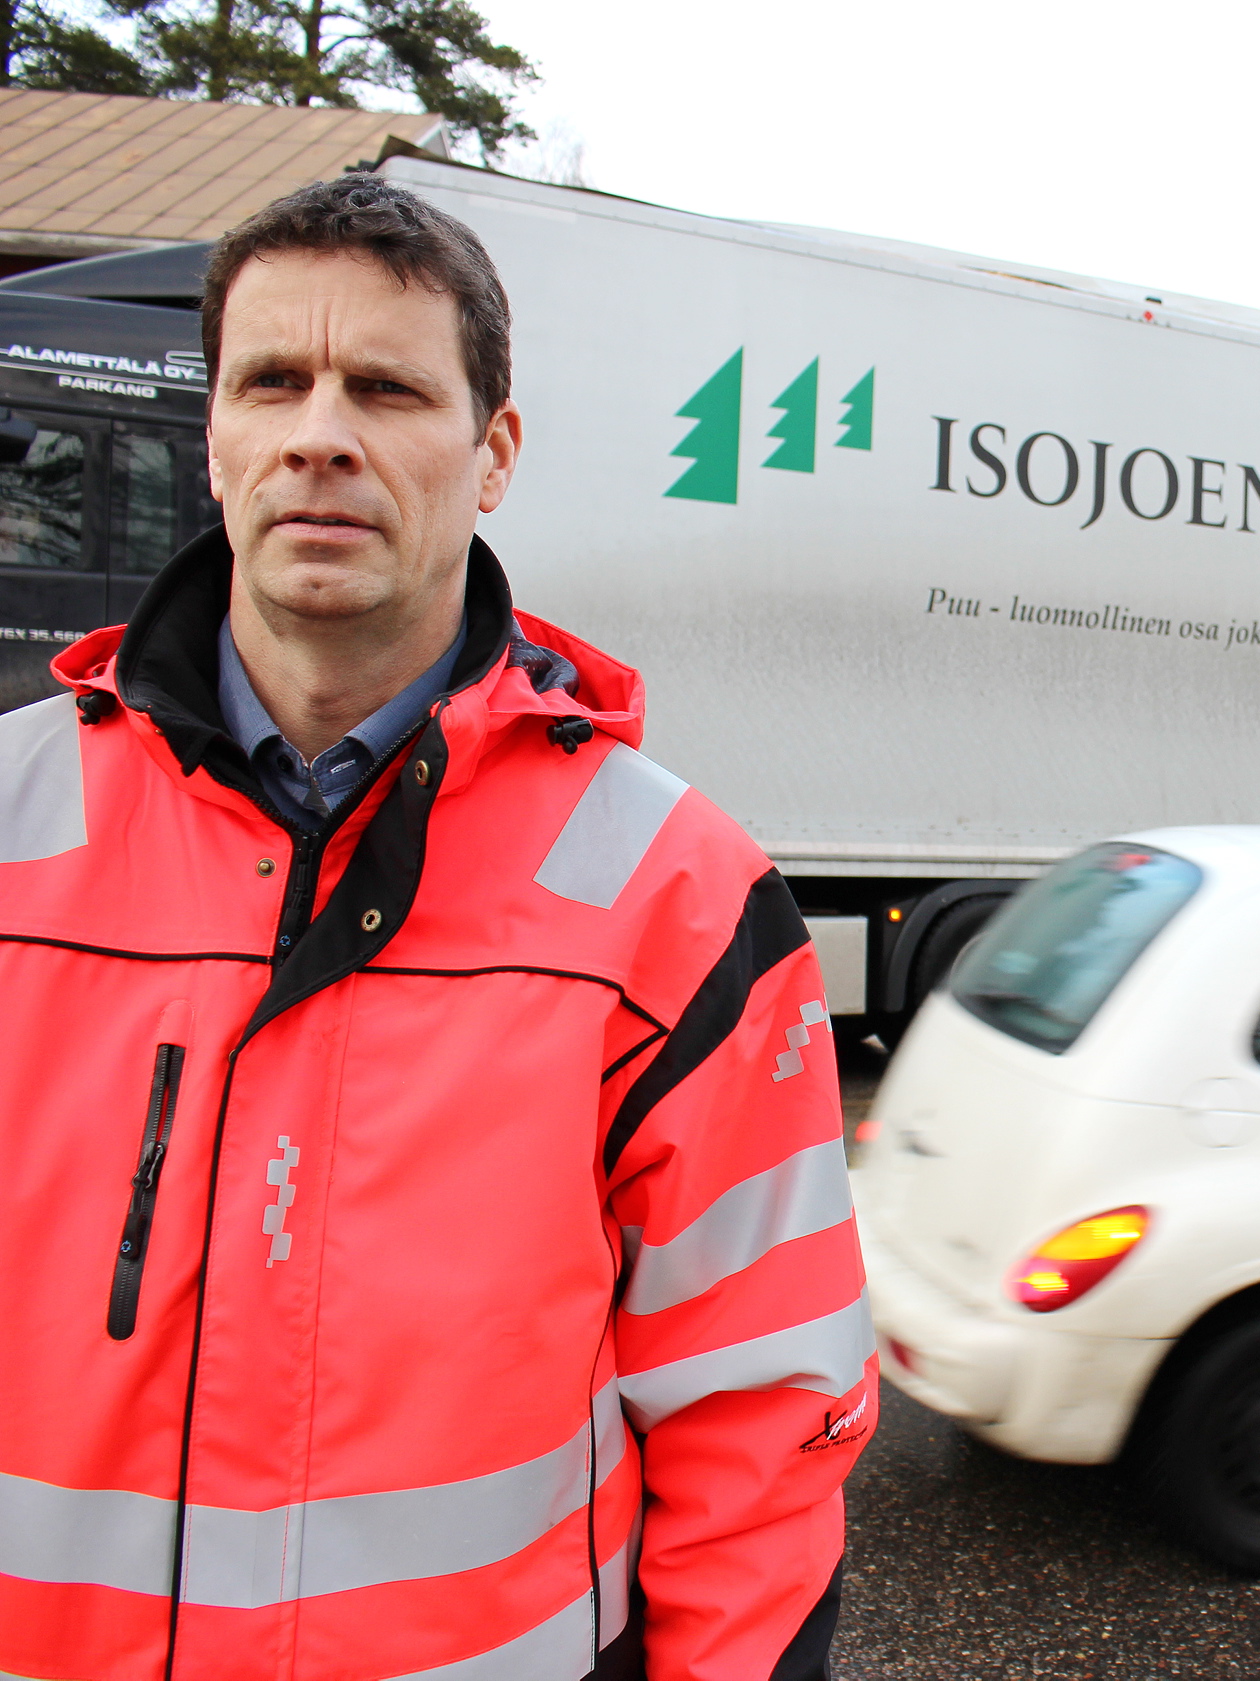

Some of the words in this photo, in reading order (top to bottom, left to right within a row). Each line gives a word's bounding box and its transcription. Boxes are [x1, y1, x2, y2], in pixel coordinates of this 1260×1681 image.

[8, 344, 163, 377] ALAMETTÄLÄ
[163, 364, 197, 380] OY
[58, 375, 158, 399] PARKANO
[925, 587, 981, 617] Puu
[1009, 595, 1172, 636] luonnollinen
[1179, 618, 1219, 641] osa
